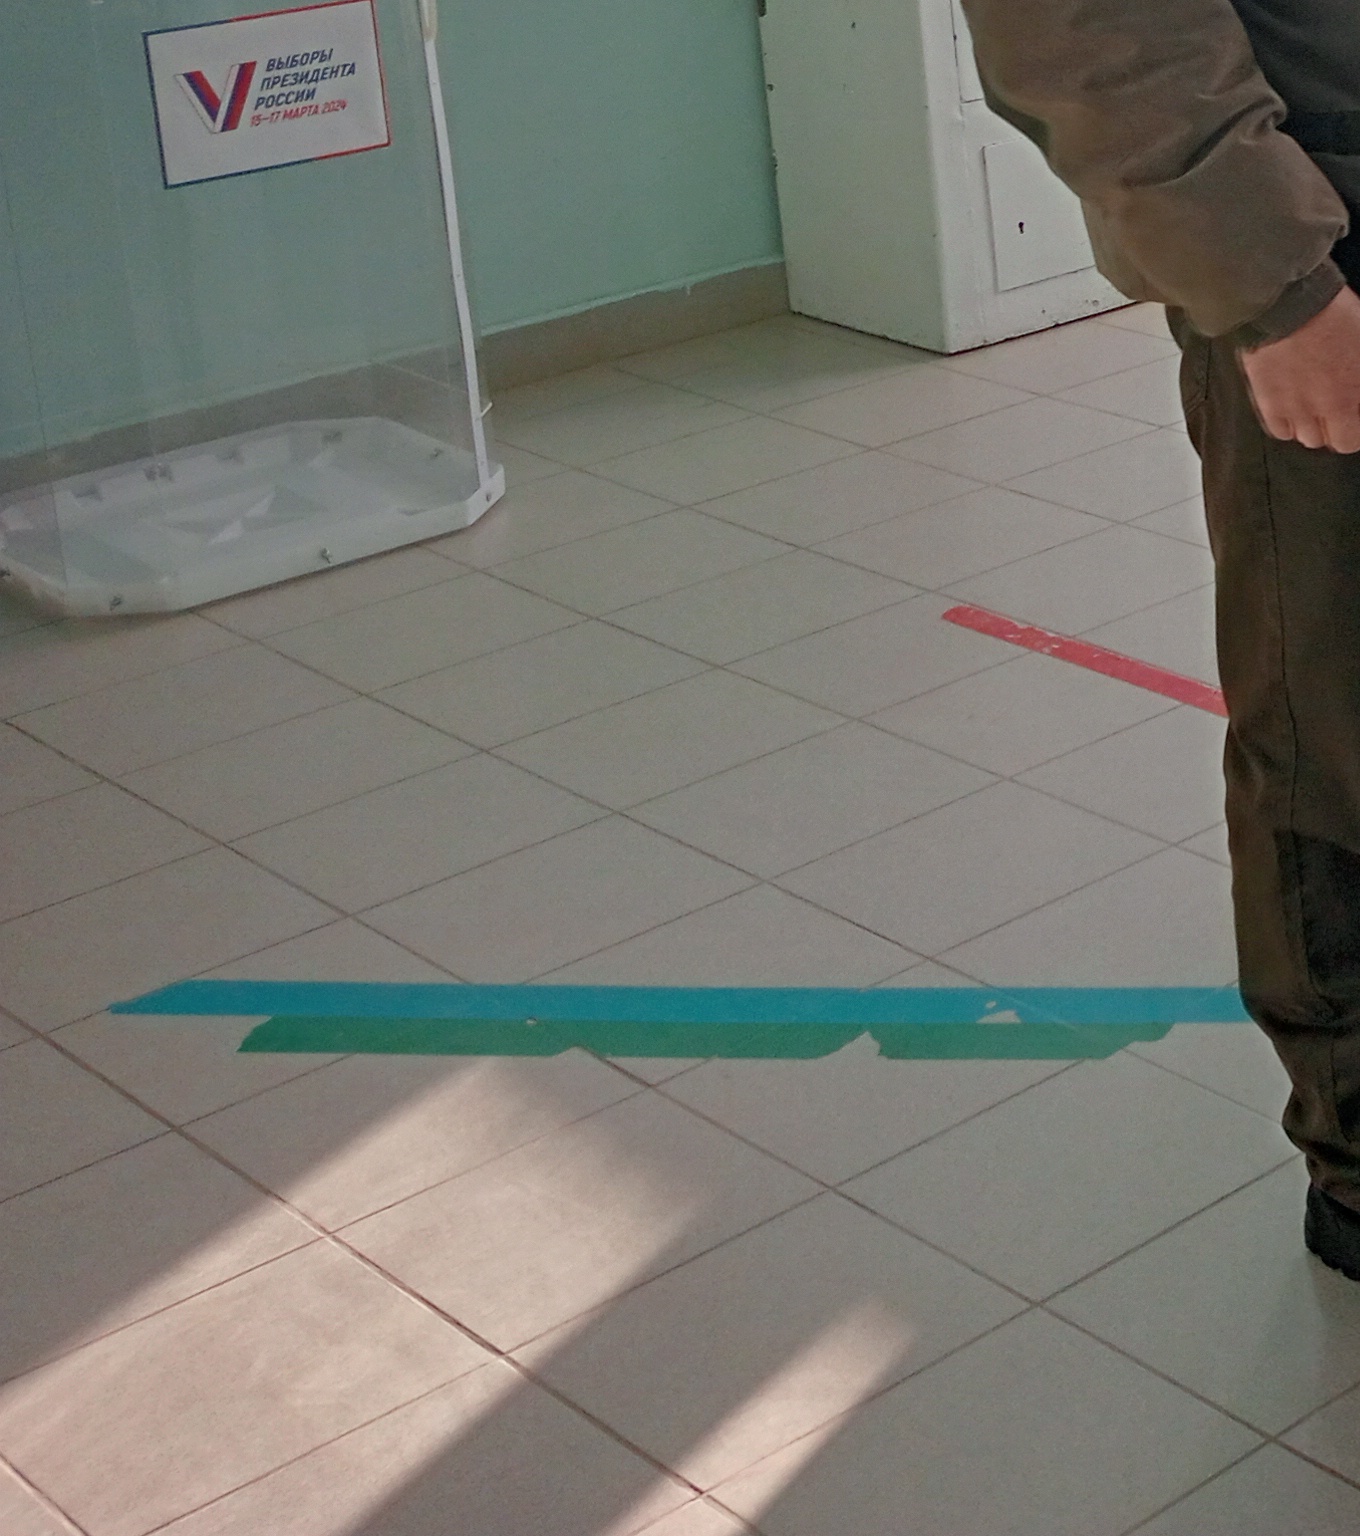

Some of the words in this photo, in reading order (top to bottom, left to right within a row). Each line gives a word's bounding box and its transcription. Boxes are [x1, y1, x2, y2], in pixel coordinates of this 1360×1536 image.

[266, 48, 333, 72] ВЫБОРЫ
[260, 62, 356, 91] ПРЕЗИДЕНТА
[254, 87, 316, 111] РОССИИ
[282, 103, 319, 120] МАРТА
[321, 99, 347, 115] 2024
